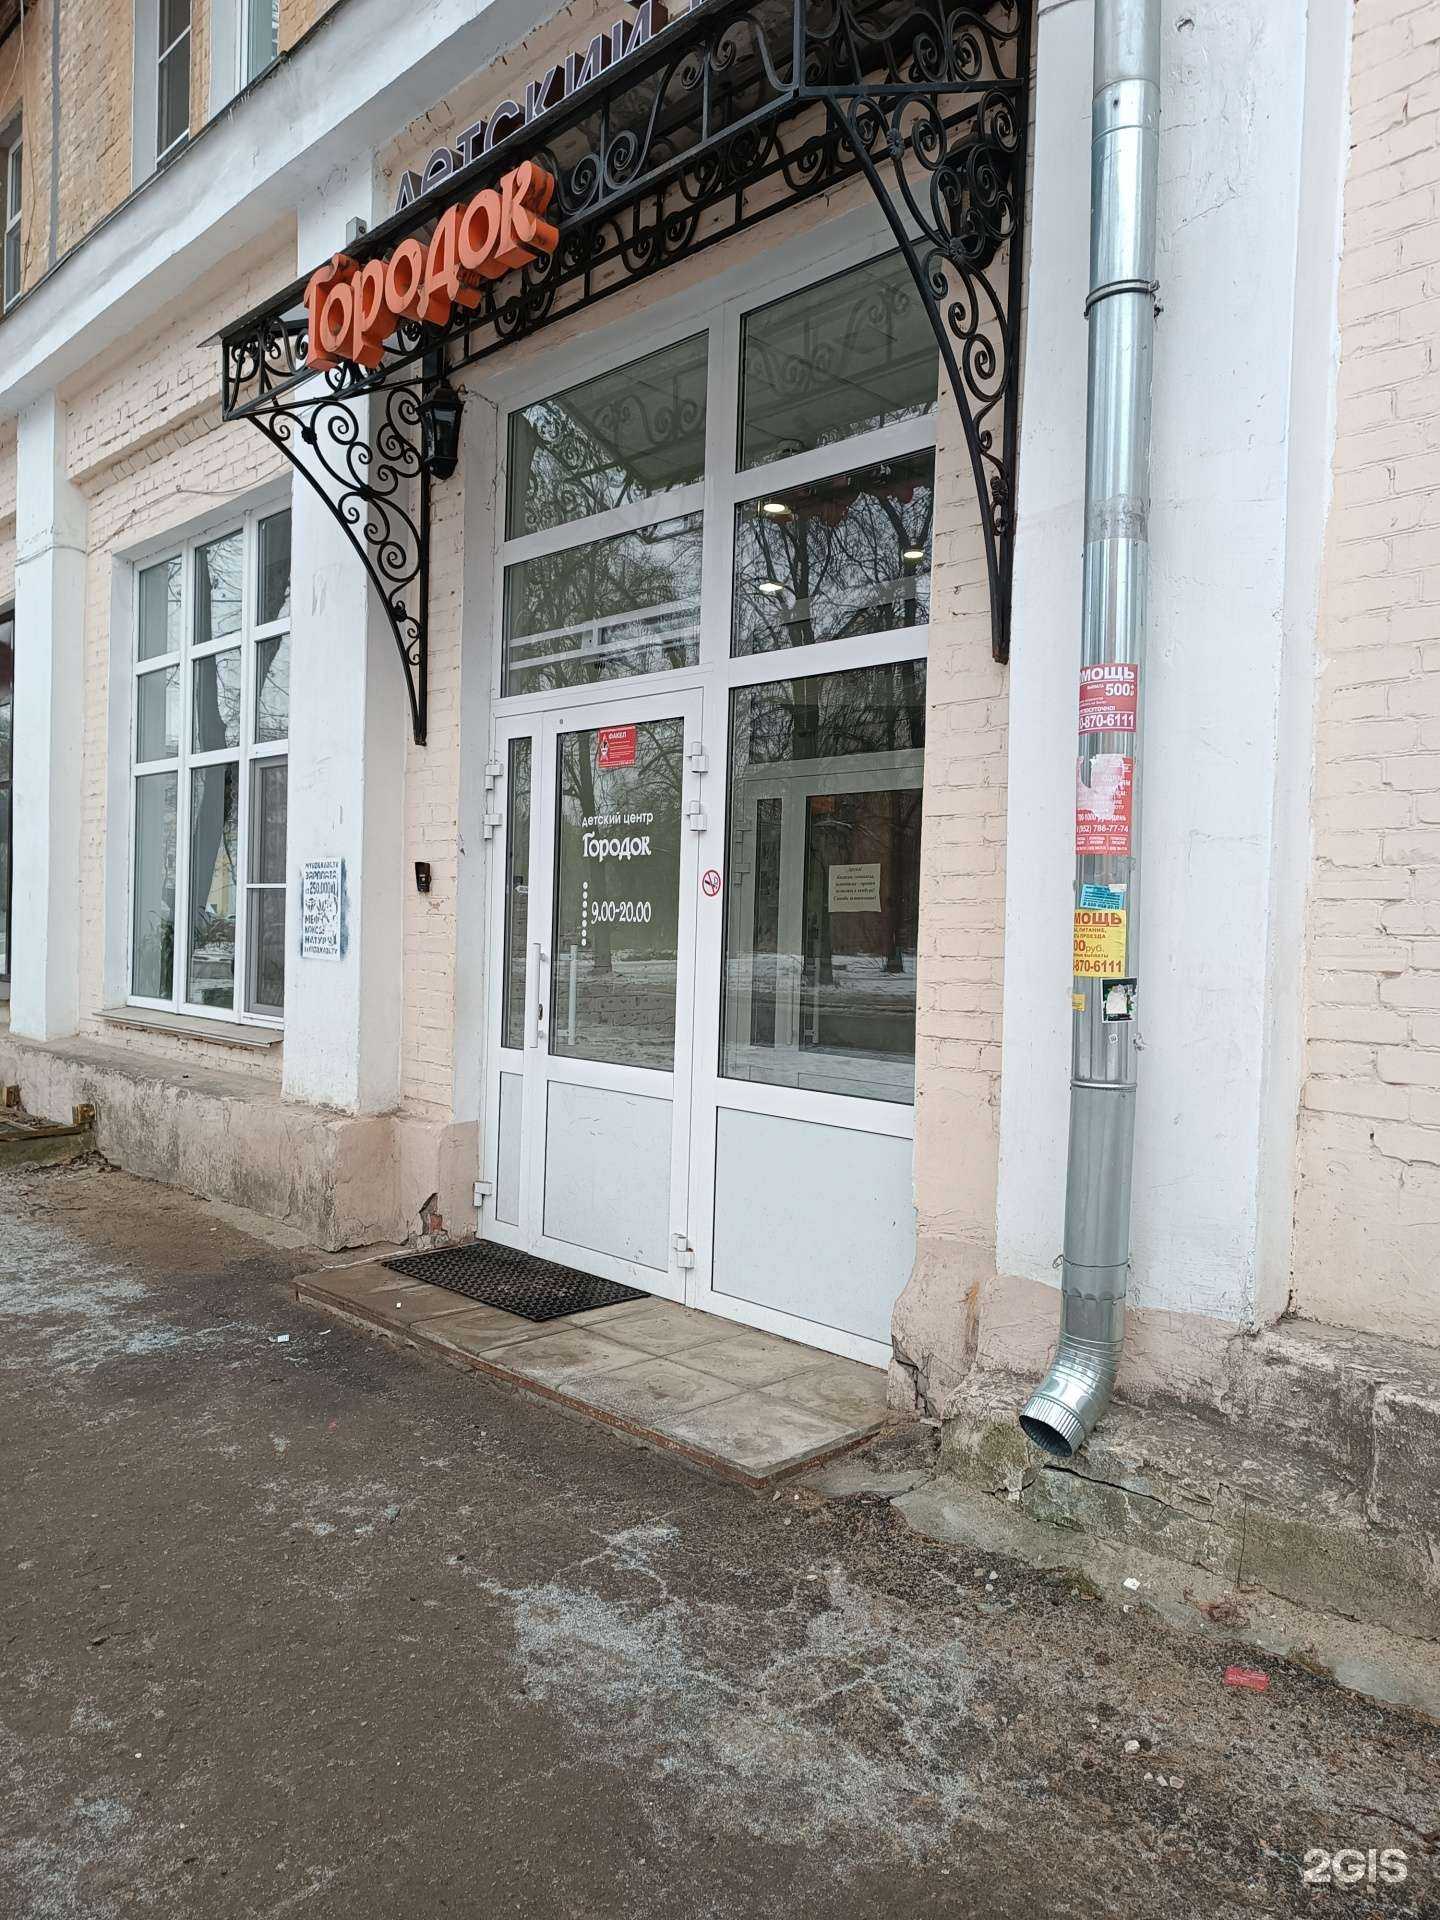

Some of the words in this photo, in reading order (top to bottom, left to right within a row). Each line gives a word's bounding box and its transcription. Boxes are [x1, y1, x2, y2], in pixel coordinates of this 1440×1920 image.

[582, 812, 621, 827] детский
[623, 812, 654, 825] центр
[583, 831, 652, 862] Городок
[591, 901, 652, 924] 9.00-20.00
